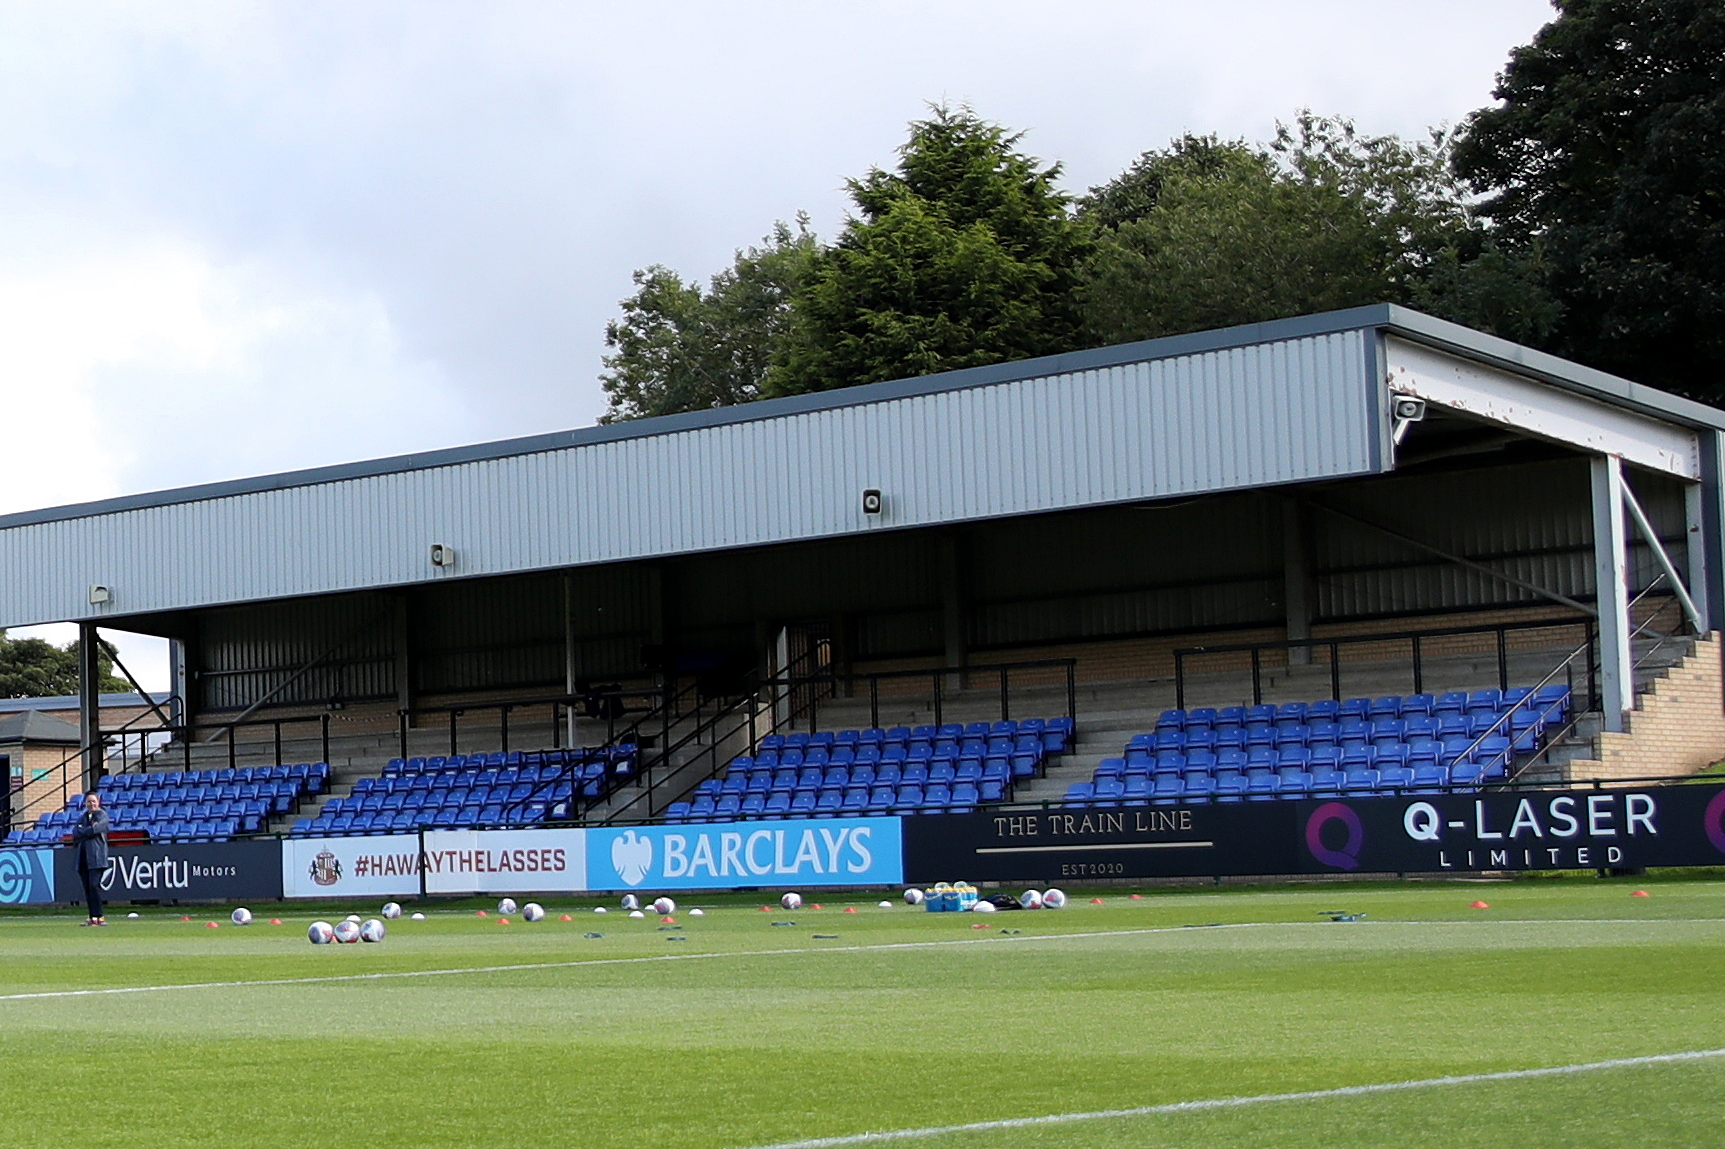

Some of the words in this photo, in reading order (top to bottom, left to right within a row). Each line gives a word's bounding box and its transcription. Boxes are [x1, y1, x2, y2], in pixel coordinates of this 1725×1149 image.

[994, 816, 1038, 837] THE
[1048, 812, 1124, 835] TRAIN
[1135, 810, 1193, 832] LINE
[1404, 794, 1657, 841] Q-LASER
[354, 849, 566, 877] #HAWAYTHELASSES
[663, 826, 873, 878] BARCLAYS
[1440, 846, 1624, 868] LIMITED
[119, 855, 189, 889] Vertu
[192, 865, 236, 877] Motors
